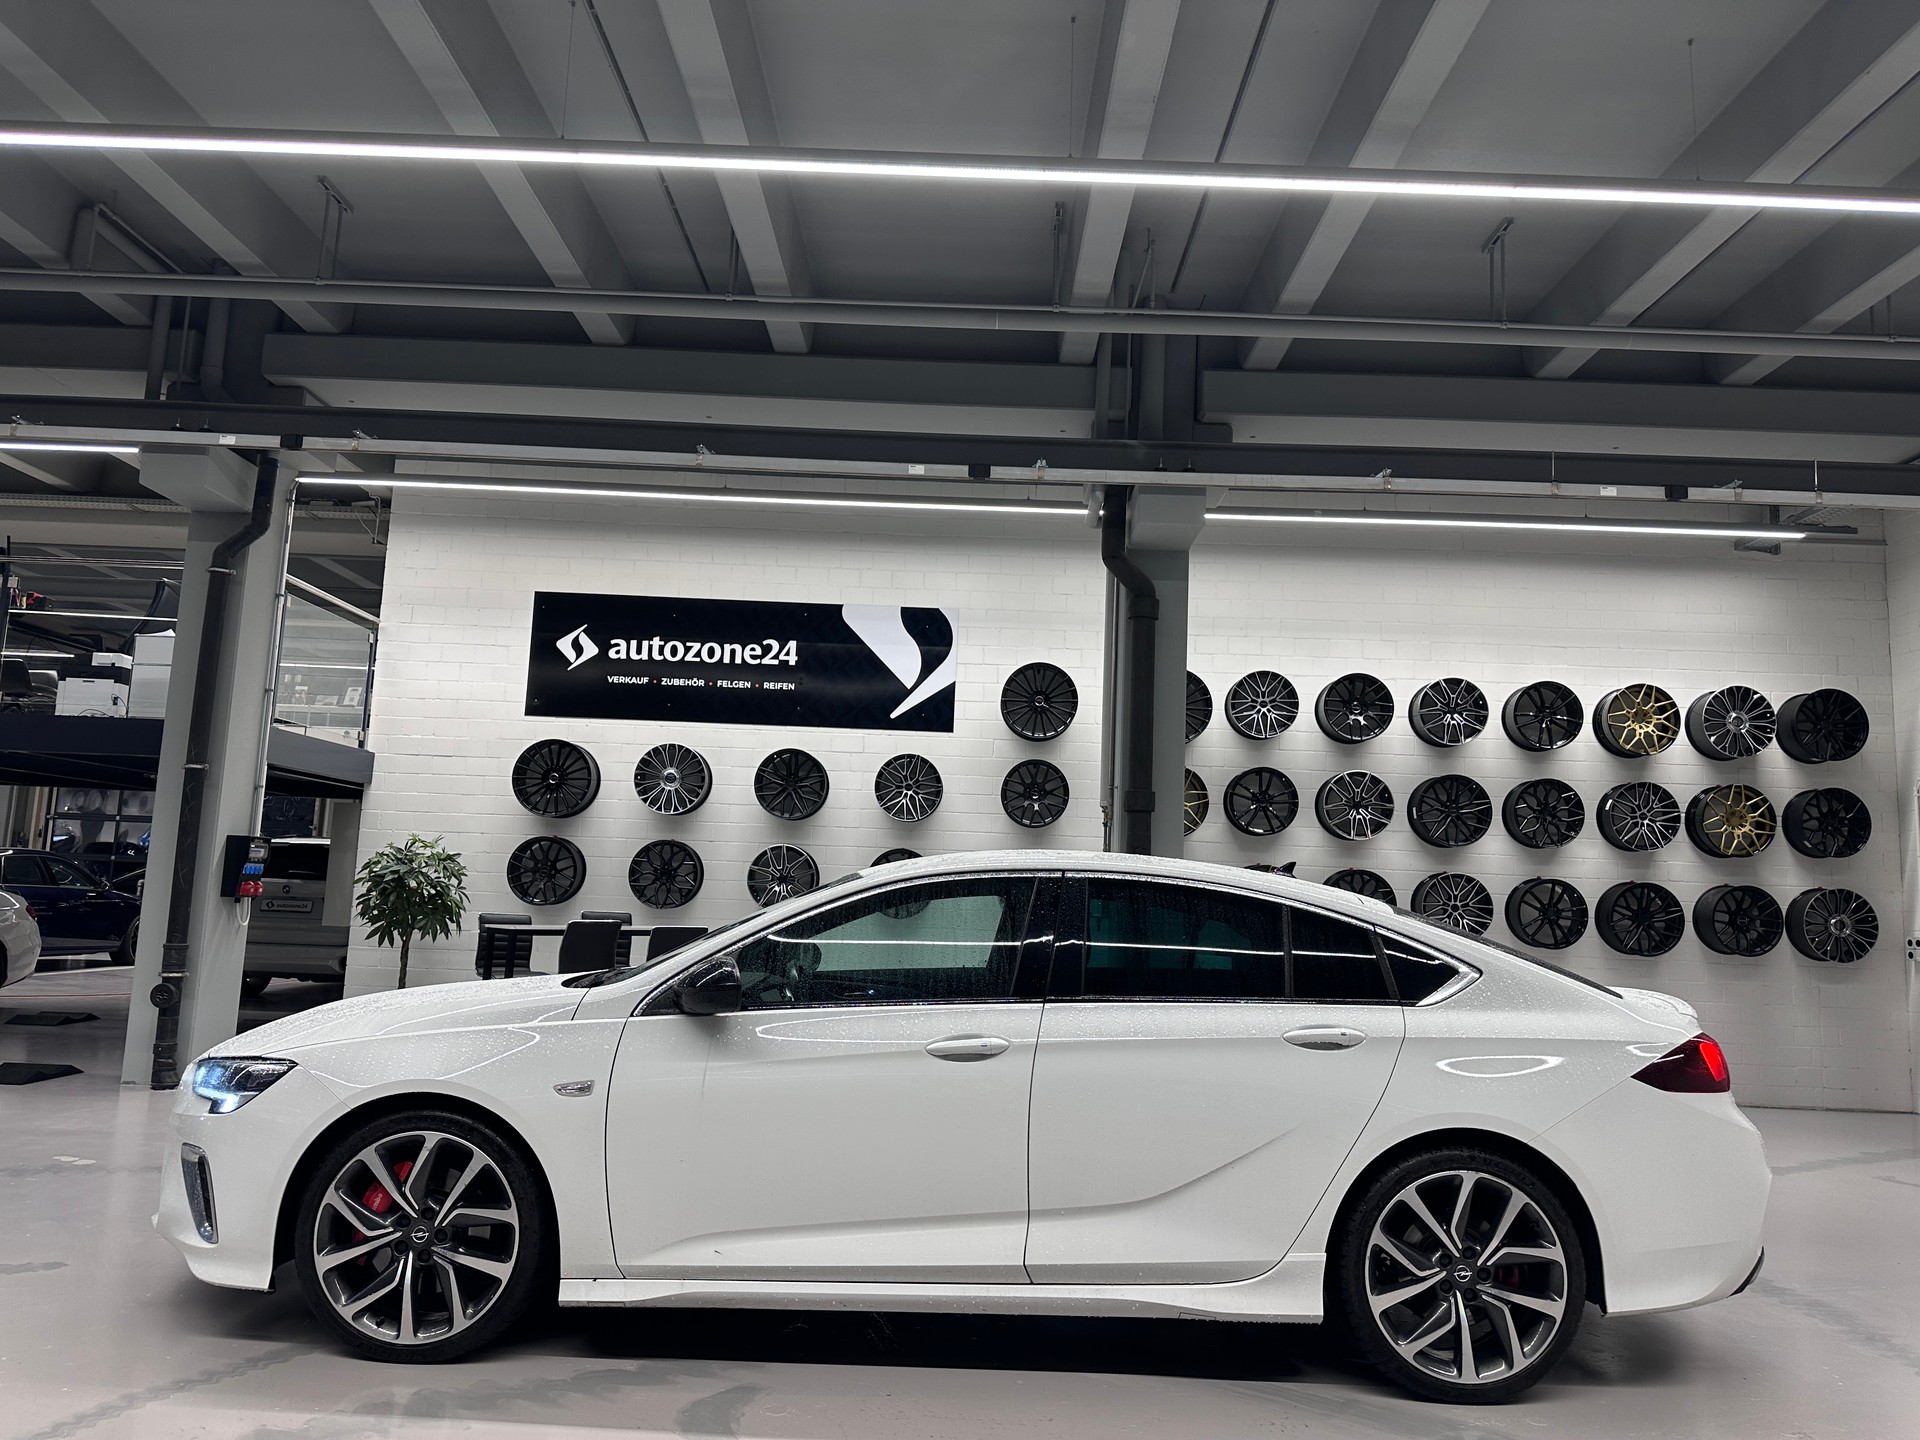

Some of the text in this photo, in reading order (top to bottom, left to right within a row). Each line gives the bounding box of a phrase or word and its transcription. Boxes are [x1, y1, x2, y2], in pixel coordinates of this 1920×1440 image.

[608, 636, 799, 666] autozone24
[607, 675, 796, 691] VERKAUF ZUBEHÖR FELGEN REIFEN
